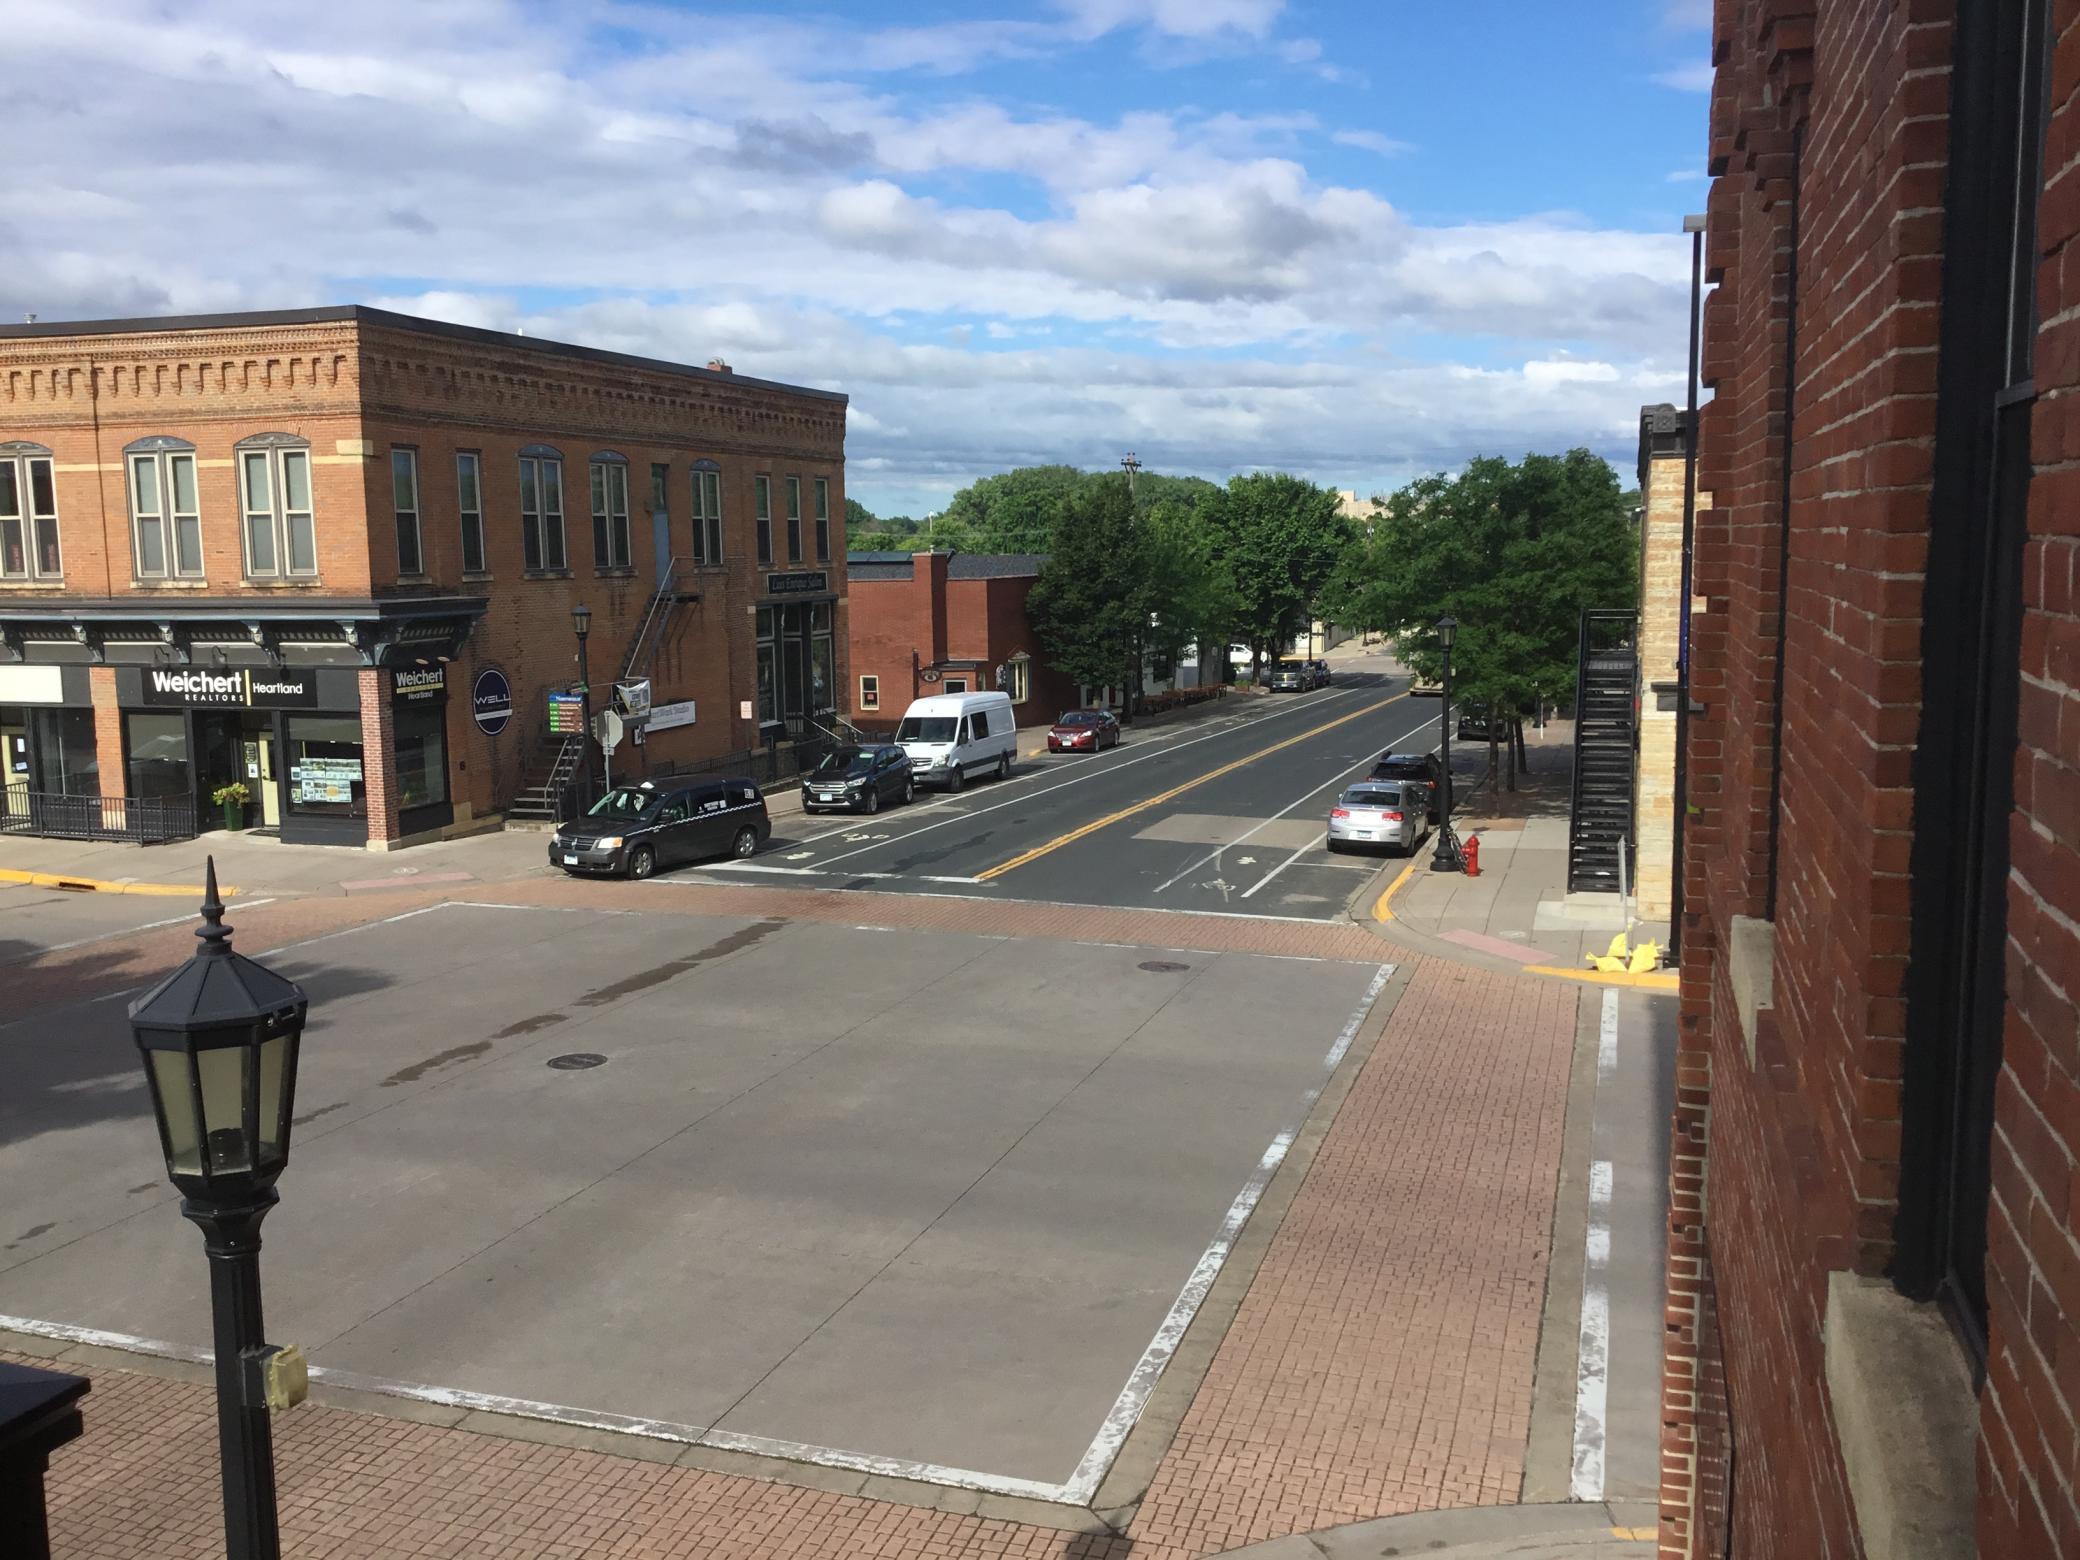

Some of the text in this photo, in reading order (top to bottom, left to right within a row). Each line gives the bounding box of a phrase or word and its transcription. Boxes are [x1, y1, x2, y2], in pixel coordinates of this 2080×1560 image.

[152, 671, 242, 693] Weichert
[396, 668, 444, 687] Weichert
[252, 682, 304, 694] Heartland
[184, 694, 244, 702] REALTORS
[474, 694, 512, 704] WELL
